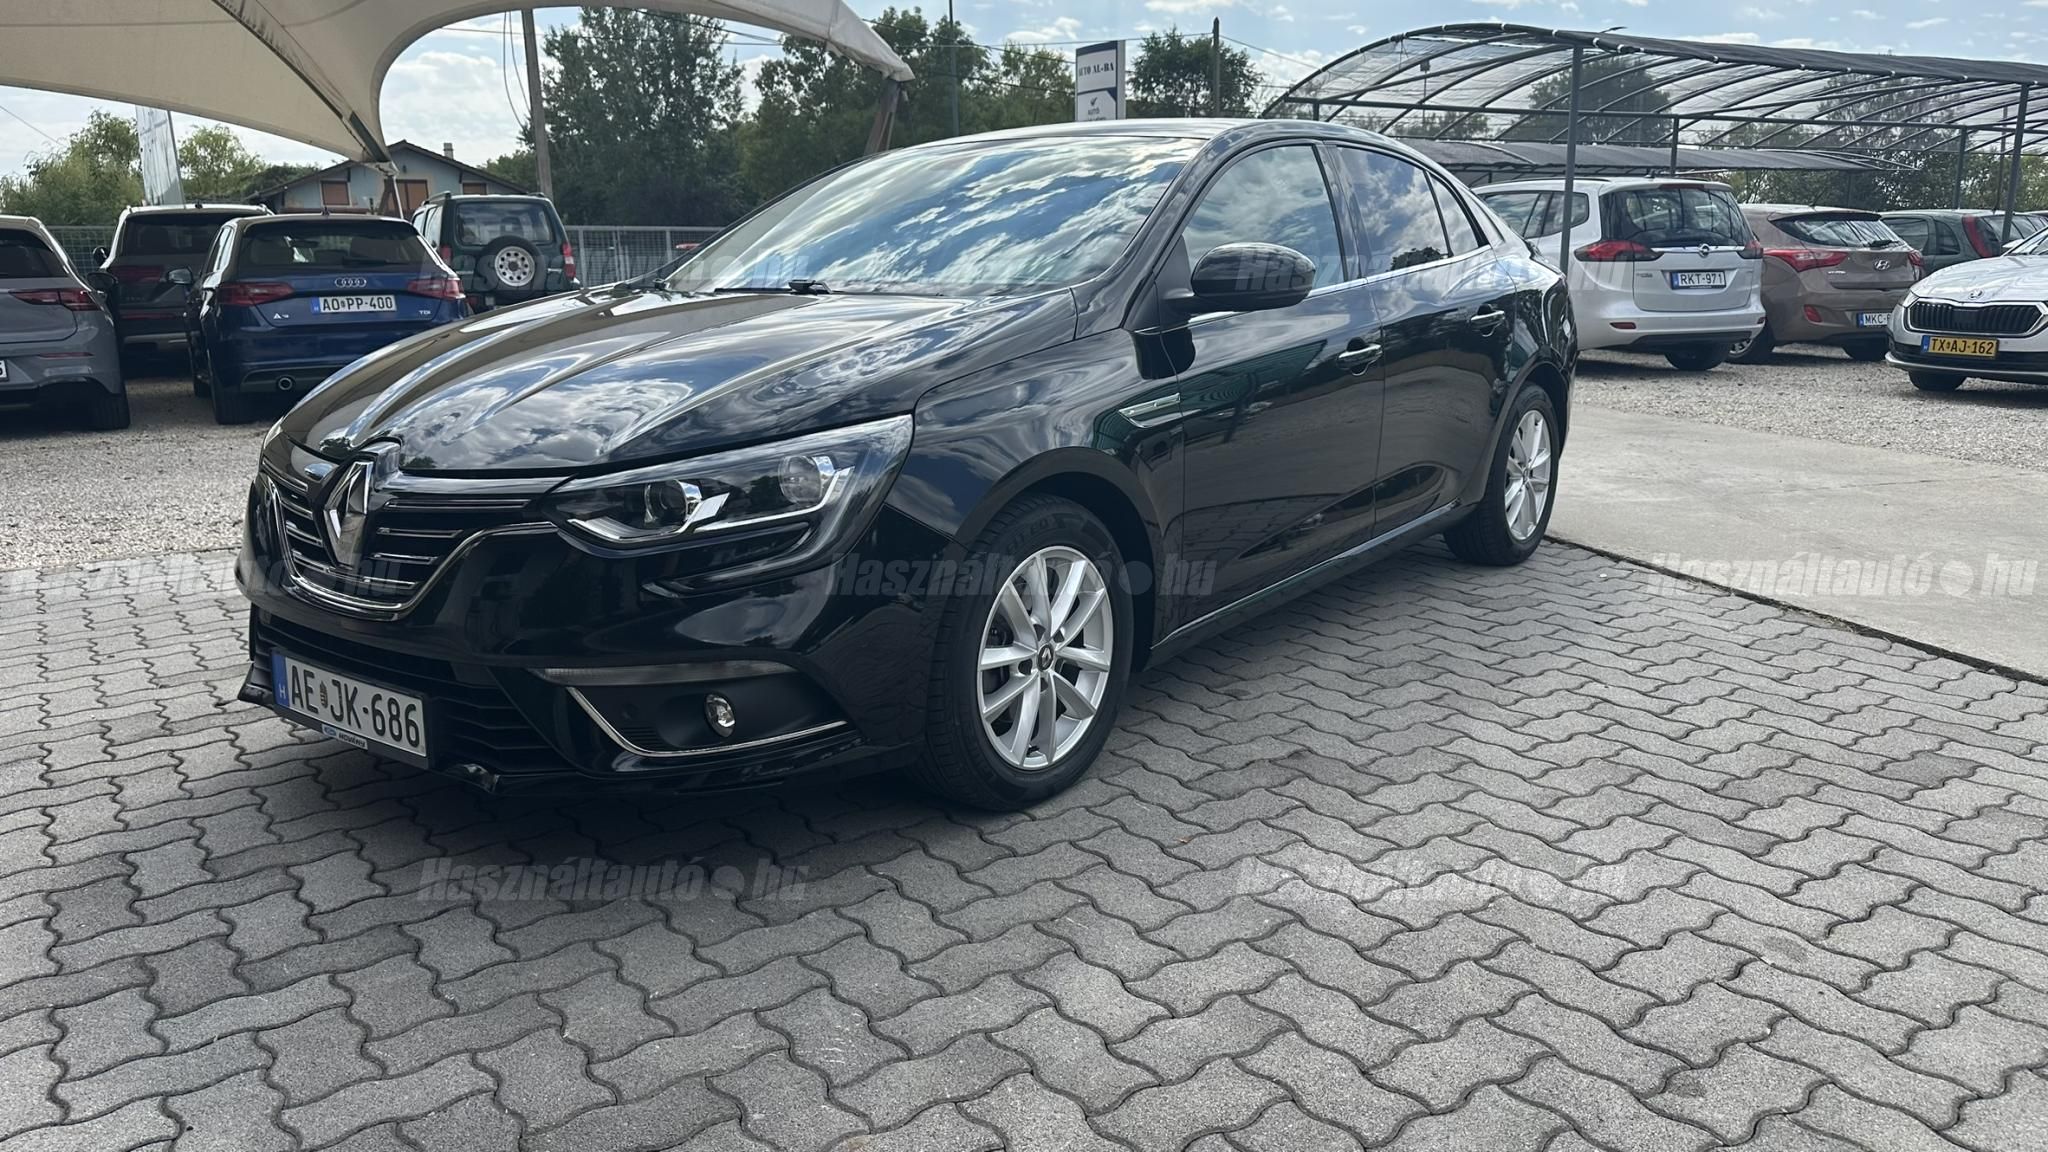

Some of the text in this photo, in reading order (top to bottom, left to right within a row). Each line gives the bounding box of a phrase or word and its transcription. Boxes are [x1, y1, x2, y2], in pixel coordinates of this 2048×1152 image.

[1680, 273, 1723, 285] RKT-971
[322, 296, 393, 311] AO PP-400
[1932, 338, 1994, 354] TX AJ-162
[278, 683, 287, 699] H
[291, 664, 420, 748] AE JK-686
